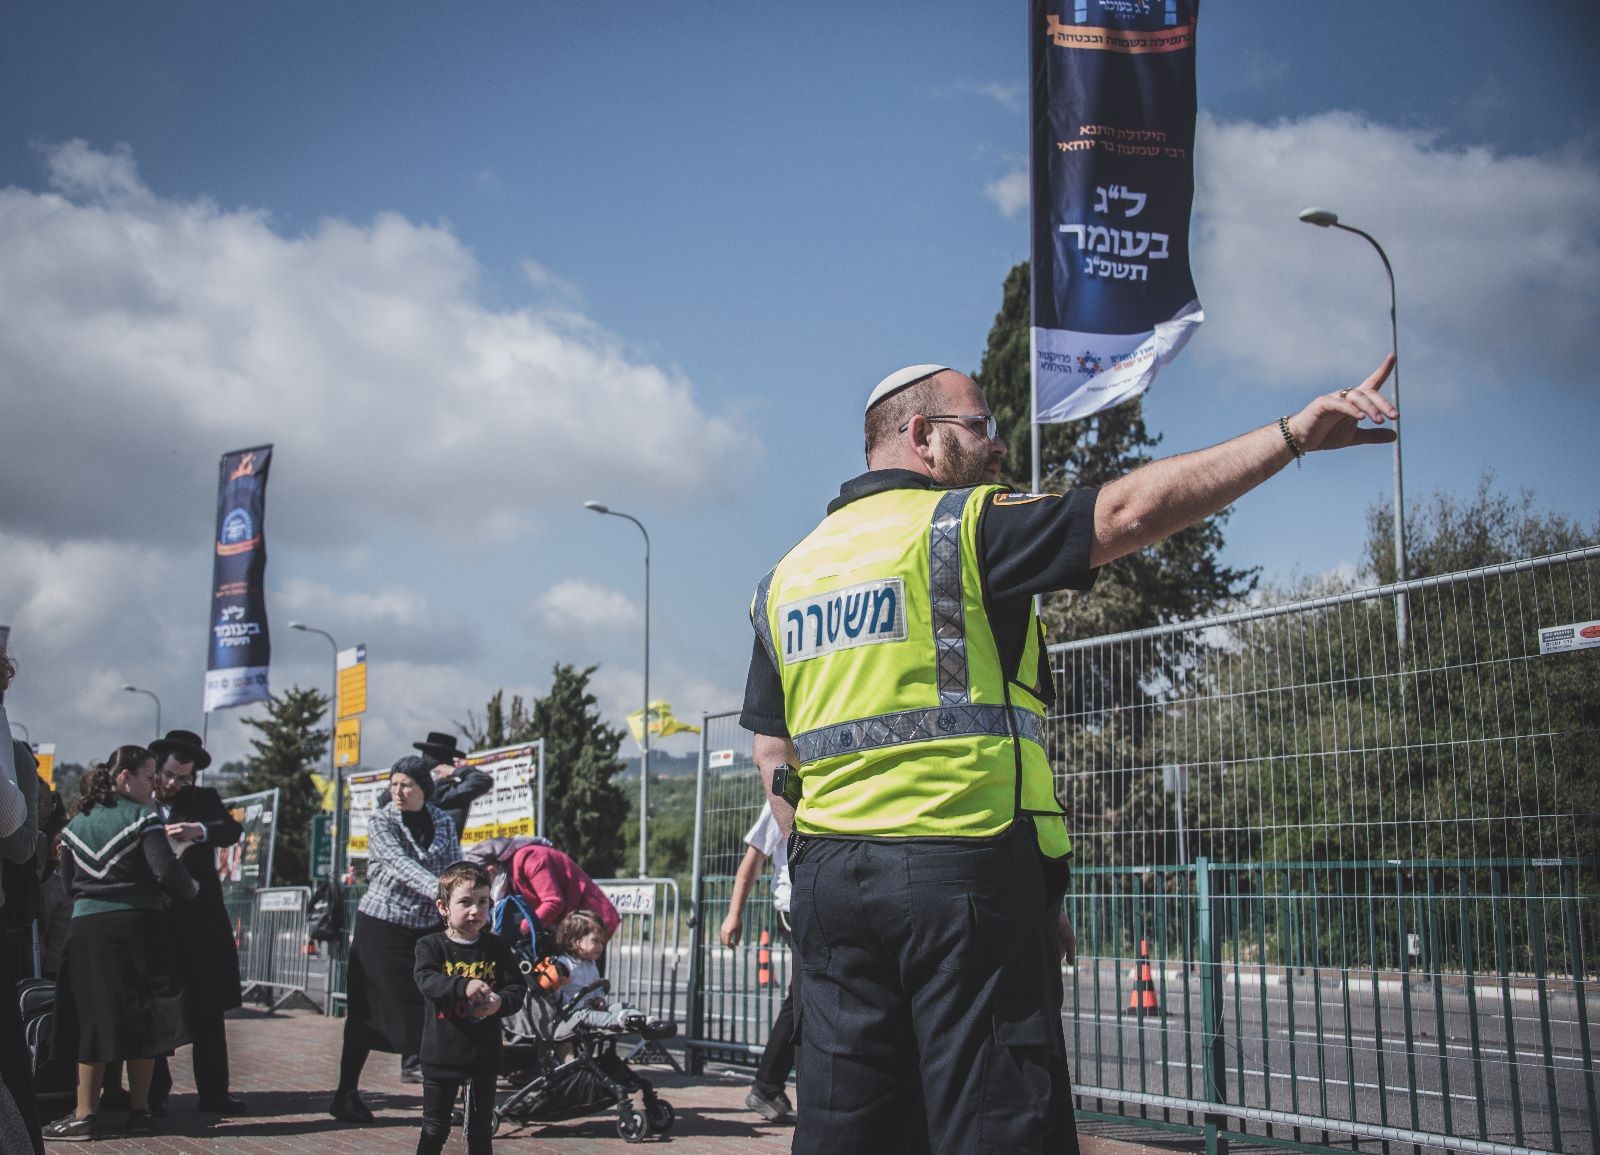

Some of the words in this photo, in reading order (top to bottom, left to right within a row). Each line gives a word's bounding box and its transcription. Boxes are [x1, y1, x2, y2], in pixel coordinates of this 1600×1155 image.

[1057, 31, 1103, 44] ובבטחה
[1106, 36, 1148, 48] בשמחה
[1080, 125, 1115, 137] התנא
[1117, 128, 1166, 141] הילולת
[1057, 140, 1095, 152] יוחאי
[1100, 140, 1115, 152] בר
[1117, 143, 1160, 156] שמעון
[1164, 147, 1185, 159] רבי
[1094, 184, 1147, 217] ל"ג
[1059, 224, 1169, 259] בעומר
[1084, 256, 1148, 281] תשפ"ג
[787, 587, 897, 655] משטרה
[213, 623, 261, 638] בעומר
[337, 732, 358, 751] הורדה
